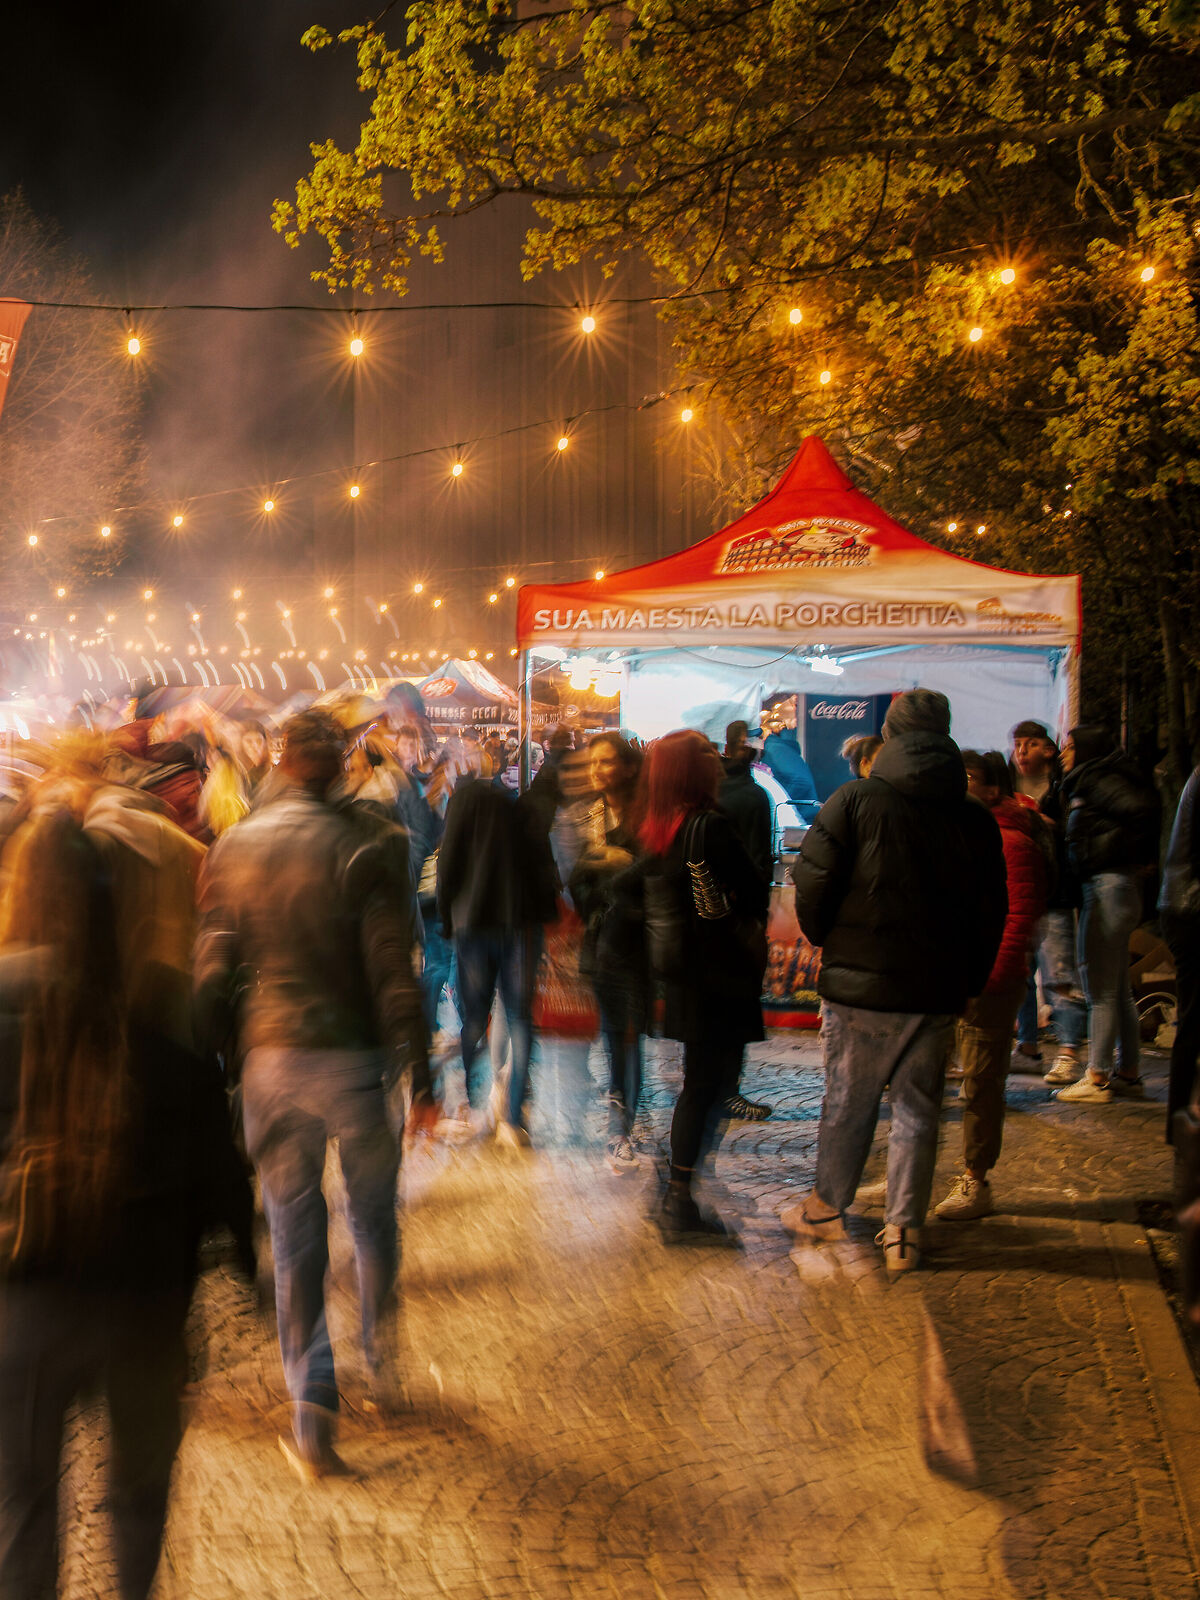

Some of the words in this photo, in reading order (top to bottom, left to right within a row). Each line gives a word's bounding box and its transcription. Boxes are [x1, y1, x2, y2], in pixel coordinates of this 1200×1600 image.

[533, 609, 594, 631] SUA
[600, 606, 723, 630] MAESTA
[730, 604, 769, 628] LA
[776, 602, 966, 627] PORCHETTA
